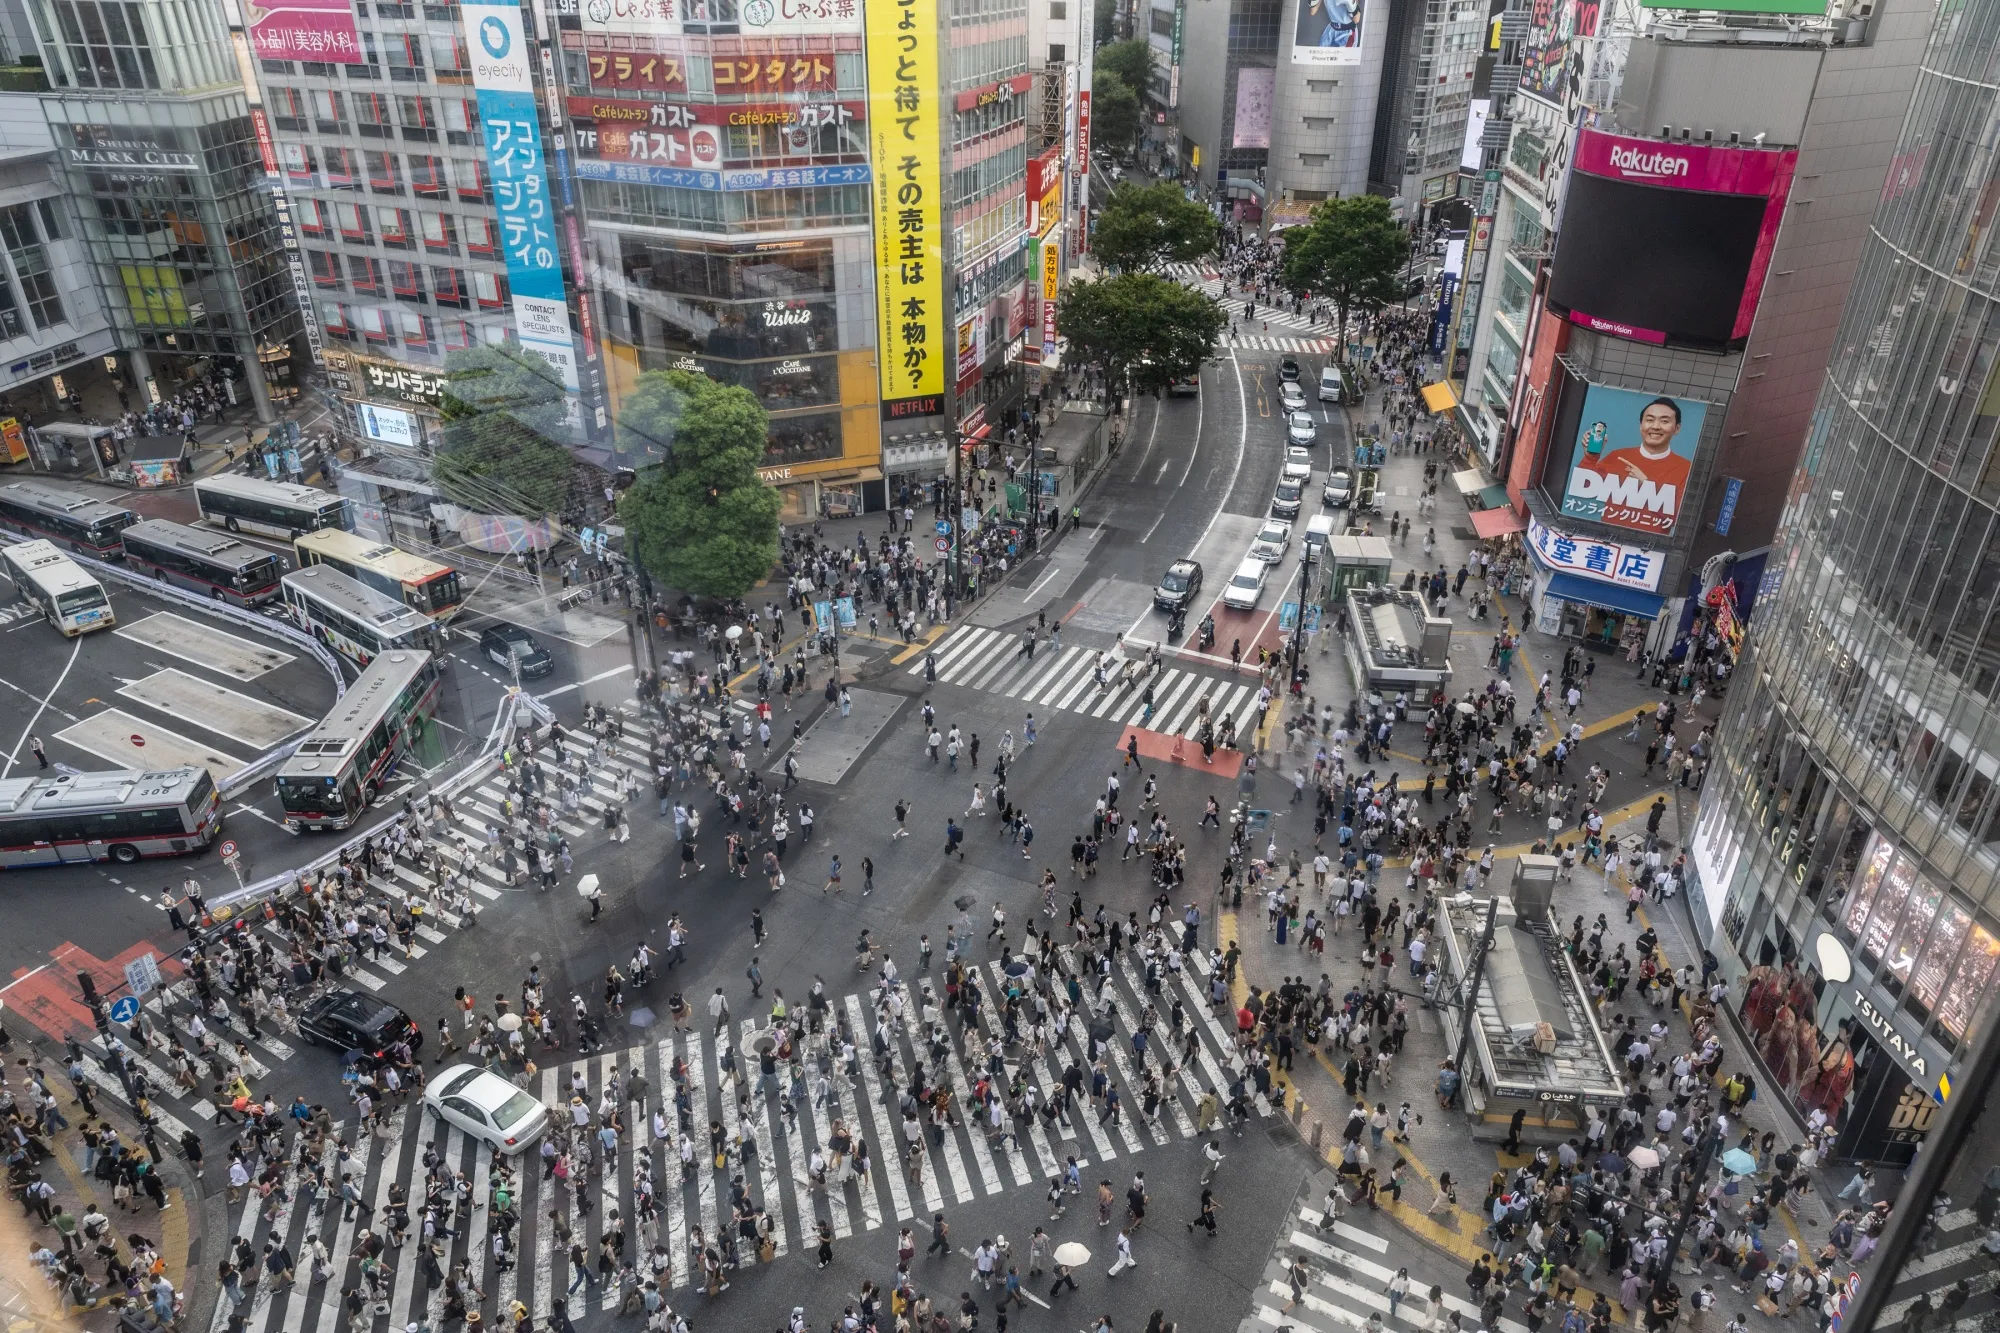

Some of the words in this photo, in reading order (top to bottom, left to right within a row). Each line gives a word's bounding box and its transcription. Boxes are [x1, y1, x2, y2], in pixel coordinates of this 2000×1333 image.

[267, 28, 354, 53] 品川美容外科
[478, 63, 523, 82] eyecity
[589, 55, 684, 82] プライス
[714, 58, 831, 84] コンタクト
[651, 103, 696, 128] ガスト
[801, 104, 853, 127] ガスト
[97, 139, 159, 149] SHIBUYA
[576, 130, 597, 148] 7F
[629, 130, 685, 161] ガスト
[1080, 124, 1088, 167] TaxFree
[71, 150, 137, 163] MARK
[145, 151, 196, 164] CITY
[1610, 146, 1689, 176] Rakuten
[615, 166, 696, 185] 英会話イーオン
[730, 174, 763, 187] AEON
[772, 167, 868, 186] 英会話イーオン
[487, 119, 531, 266] アイシティ
[516, 121, 553, 269] コンタクトの
[897, 155, 924, 285] その売主は
[524, 304, 556, 315] CONTACT
[533, 314, 551, 323] LENS
[762, 310, 811, 327] Ushi8
[1045, 303, 1055, 341] スギ薬局
[522, 321, 565, 334] SPECIALISTS
[1591, 318, 1613, 330] Rakuten
[1614, 323, 1632, 335] Vision
[1004, 336, 1022, 365] LUSH
[891, 399, 936, 416] NETFLIX
[1568, 467, 1676, 515] DMM
[1565, 498, 1673, 529] オンラインクリニック
[1531, 520, 1650, 580] 大盛堂書店
[141, 787, 170, 797] 306
[1853, 989, 1926, 1077] TSUTAYA
